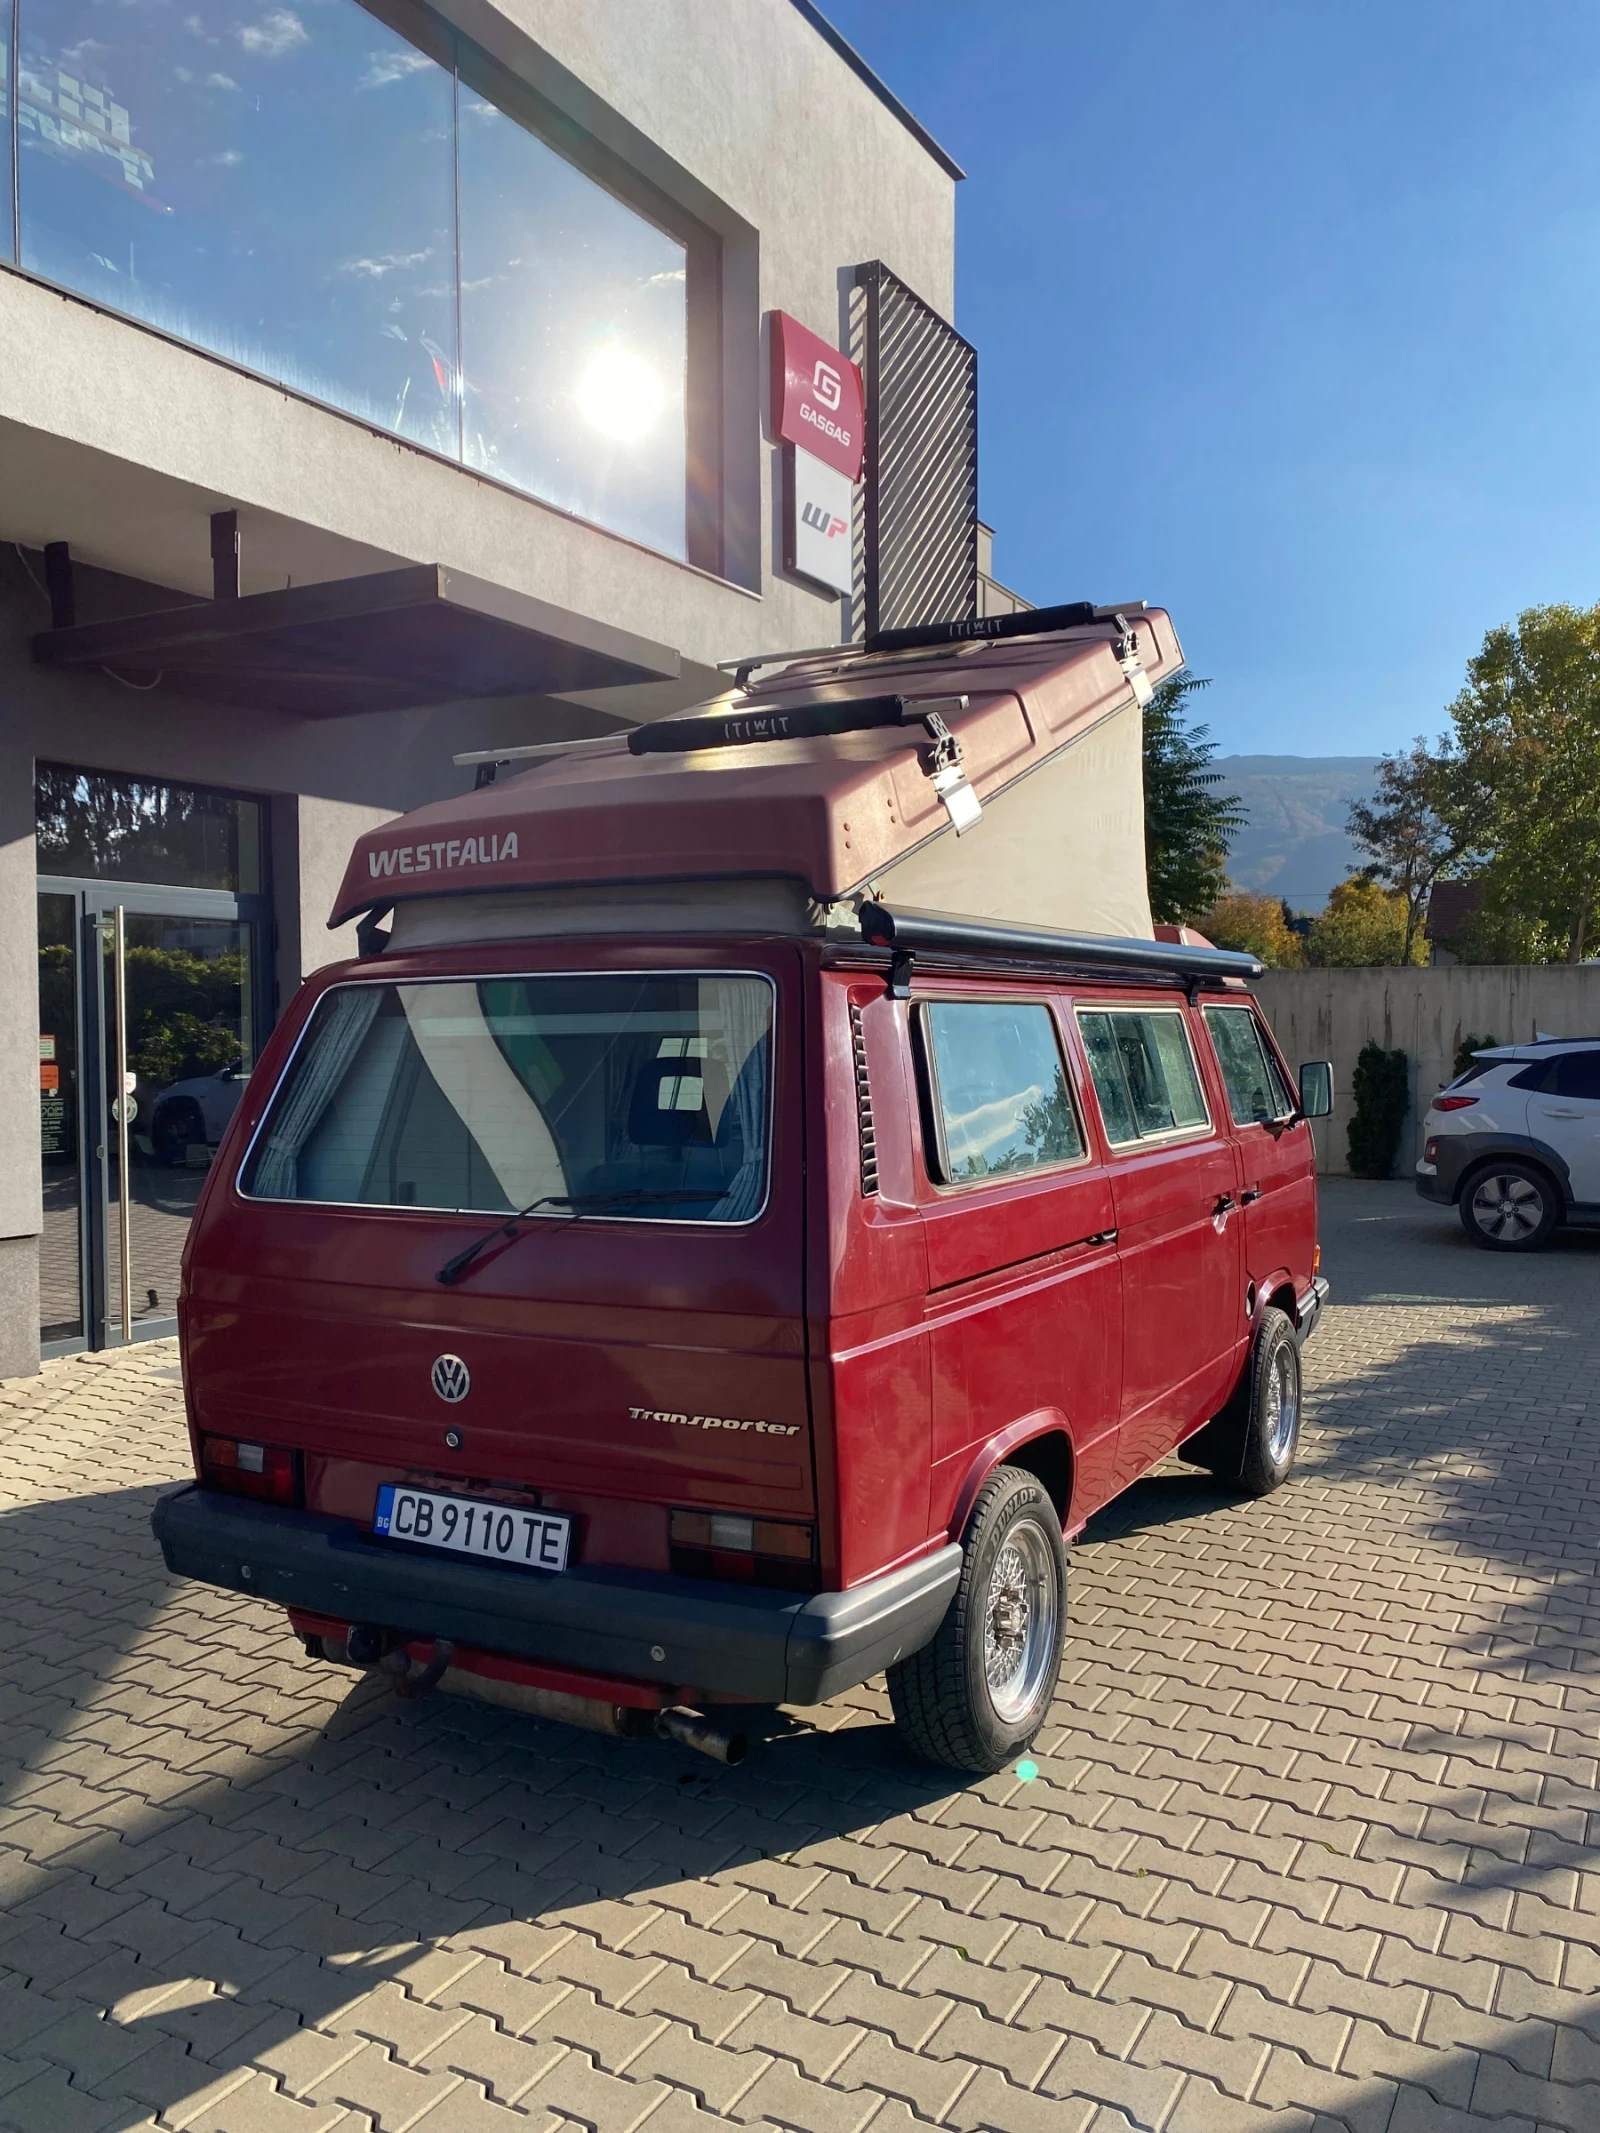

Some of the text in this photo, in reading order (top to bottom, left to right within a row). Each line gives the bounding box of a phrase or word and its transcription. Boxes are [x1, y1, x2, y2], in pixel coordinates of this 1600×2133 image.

[800, 403, 851, 447] GASGAS
[801, 502, 848, 538] WP
[950, 619, 1002, 636] ITIWIT
[724, 716, 789, 739] ITIWIT
[368, 832, 519, 878] WESTFALIA
[432, 1355, 469, 1402] VW
[628, 1407, 801, 1436] Transporter
[376, 1515, 390, 1529] BG
[395, 1495, 562, 1564] CB 9110 TE
[990, 1488, 1037, 1550] DUNLOP
